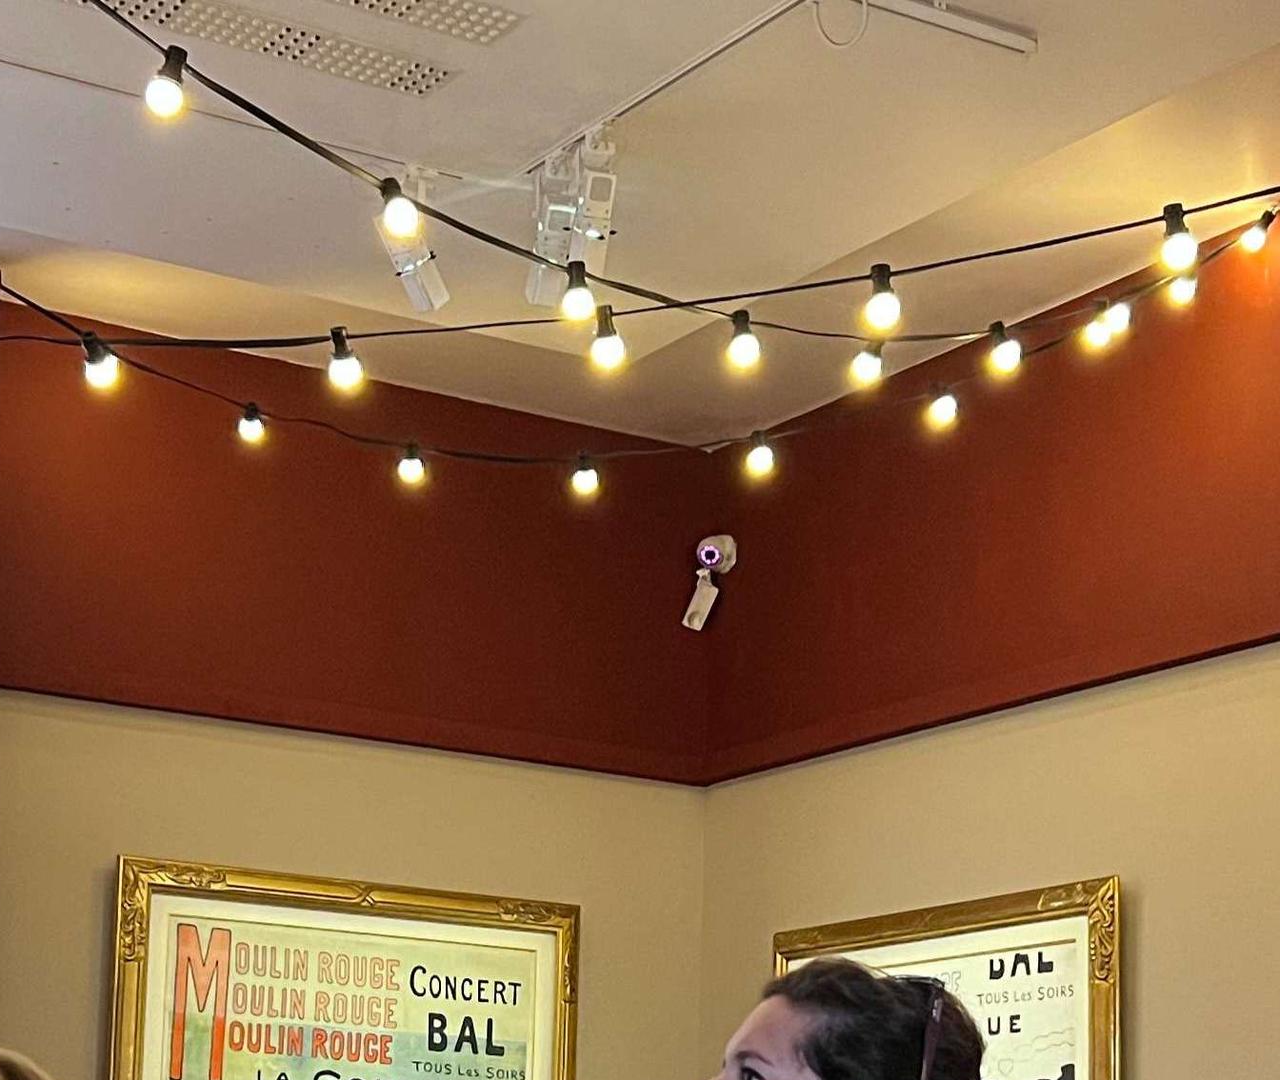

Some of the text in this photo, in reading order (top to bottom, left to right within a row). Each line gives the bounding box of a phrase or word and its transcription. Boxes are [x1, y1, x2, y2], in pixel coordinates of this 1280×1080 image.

[318, 951, 401, 991] ROUGE
[409, 965, 522, 1006] CONCERT
[314, 991, 398, 1029] ROUGE
[976, 991, 1009, 1006] TOUS
[1037, 984, 1075, 1001] SOIRS
[311, 1028, 394, 1065] ROUGE
[427, 1012, 506, 1057] BAL
[412, 1060, 452, 1075] TOUS
